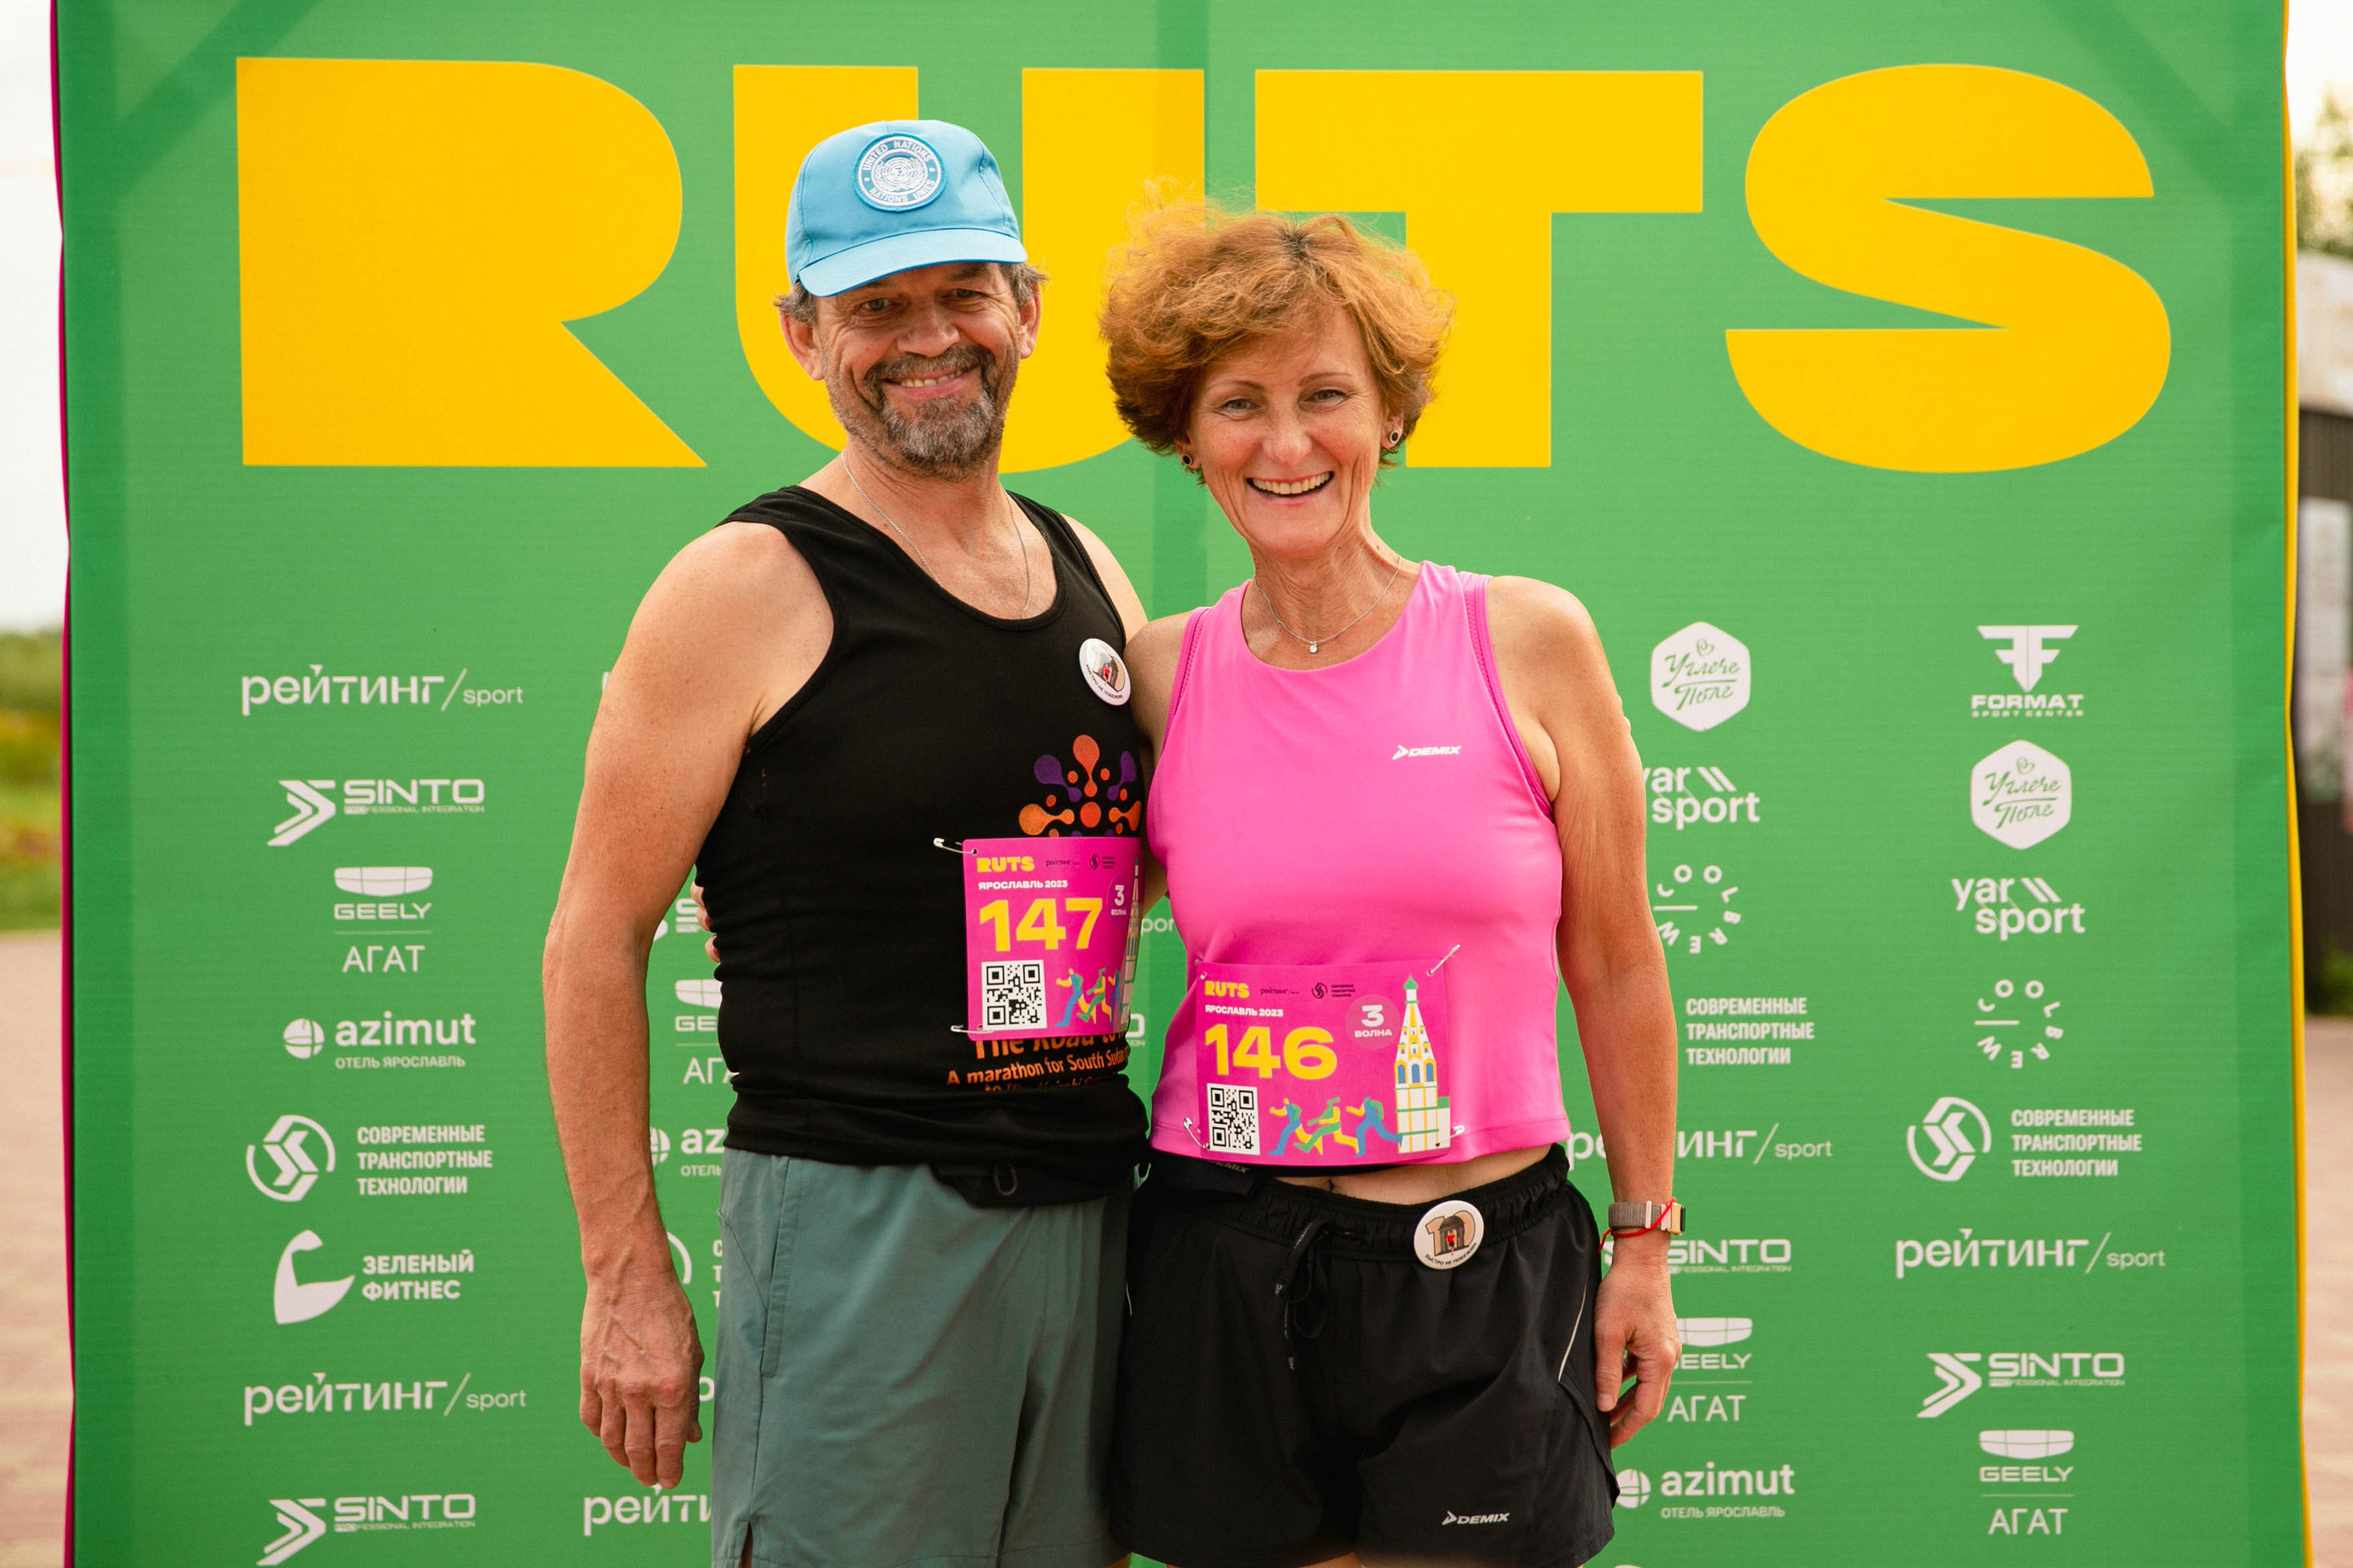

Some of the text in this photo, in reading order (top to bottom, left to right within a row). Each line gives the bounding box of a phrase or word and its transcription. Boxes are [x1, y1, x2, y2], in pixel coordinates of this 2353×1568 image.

[862, 140, 932, 171] UNITED NATIONS
[869, 187, 908, 203] NATIONS
[238, 59, 2171, 472] RUTS
[1971, 694, 2084, 710] FORMAT
[1972, 710, 2084, 718] SPORT CENTER
[1408, 745, 1461, 757] DEMIX
[344, 779, 484, 804] SINTO
[1651, 793, 1760, 831] sport
[977, 858, 1034, 872] RUTS
[979, 881, 1068, 891] ЯРОСЛАВЛЬ 2023
[1115, 885, 1125, 906] 3
[1951, 878, 2015, 911] yar
[335, 903, 432, 920] GEELY
[980, 898, 1102, 952] 147
[1974, 903, 2086, 941] sport
[343, 946, 426, 972] АГАТ
[1205, 981, 1249, 999] RUTS
[1205, 1005, 1284, 1017] ЯРОСЛАВЛЬ 2023
[1361, 1005, 1384, 1027] 3
[1686, 997, 1807, 1016] СОВРЕМЕННЫЕ
[335, 1011, 476, 1047] azimut
[1354, 1028, 1392, 1038] ВОЛНА
[1686, 1022, 1814, 1040] ТРАНСПОРТНЫЕ
[1205, 1024, 1337, 1080] 146
[1686, 1048, 1790, 1065] ТЕХНОЛОГИИ
[335, 1055, 466, 1069] ОТЕЛЬ ЯРОСЛАВЛЬ
[947, 1070, 961, 1085] A
[967, 1062, 1043, 1084] marathon
[1045, 1057, 1064, 1074] for
[1067, 1051, 1105, 1071] South
[2011, 1109, 2134, 1127] СОВРЕМЕННЫЕ
[358, 1125, 485, 1144] СОВРЕМЕННЫЕ
[2011, 1134, 2143, 1152] ТРАНСПОРТНЫЕ
[358, 1151, 493, 1169] ТРАНСПОРТНЫЕ
[2011, 1159, 2118, 1176] ТЕХНОЛОГИИ
[358, 1176, 467, 1195] ТЕХНОЛОГИИ
[362, 1249, 474, 1275] ЗЕЛЕНЫЙ
[362, 1280, 460, 1301] ФИТНЕС
[1674, 1354, 1752, 1369] EELY
[1988, 1353, 2124, 1378] SINTO
[1667, 1395, 1746, 1422] АГАТ
[1661, 1461, 1795, 1496] azimut
[1980, 1467, 2074, 1482] GEELY
[335, 1494, 475, 1521] SINTO
[1661, 1506, 1786, 1519] ОТЕЛЬ ЯРОСЛАВЛЬ
[1457, 1513, 1510, 1525] DEMIX
[1988, 1509, 2068, 1534] АГАТ
